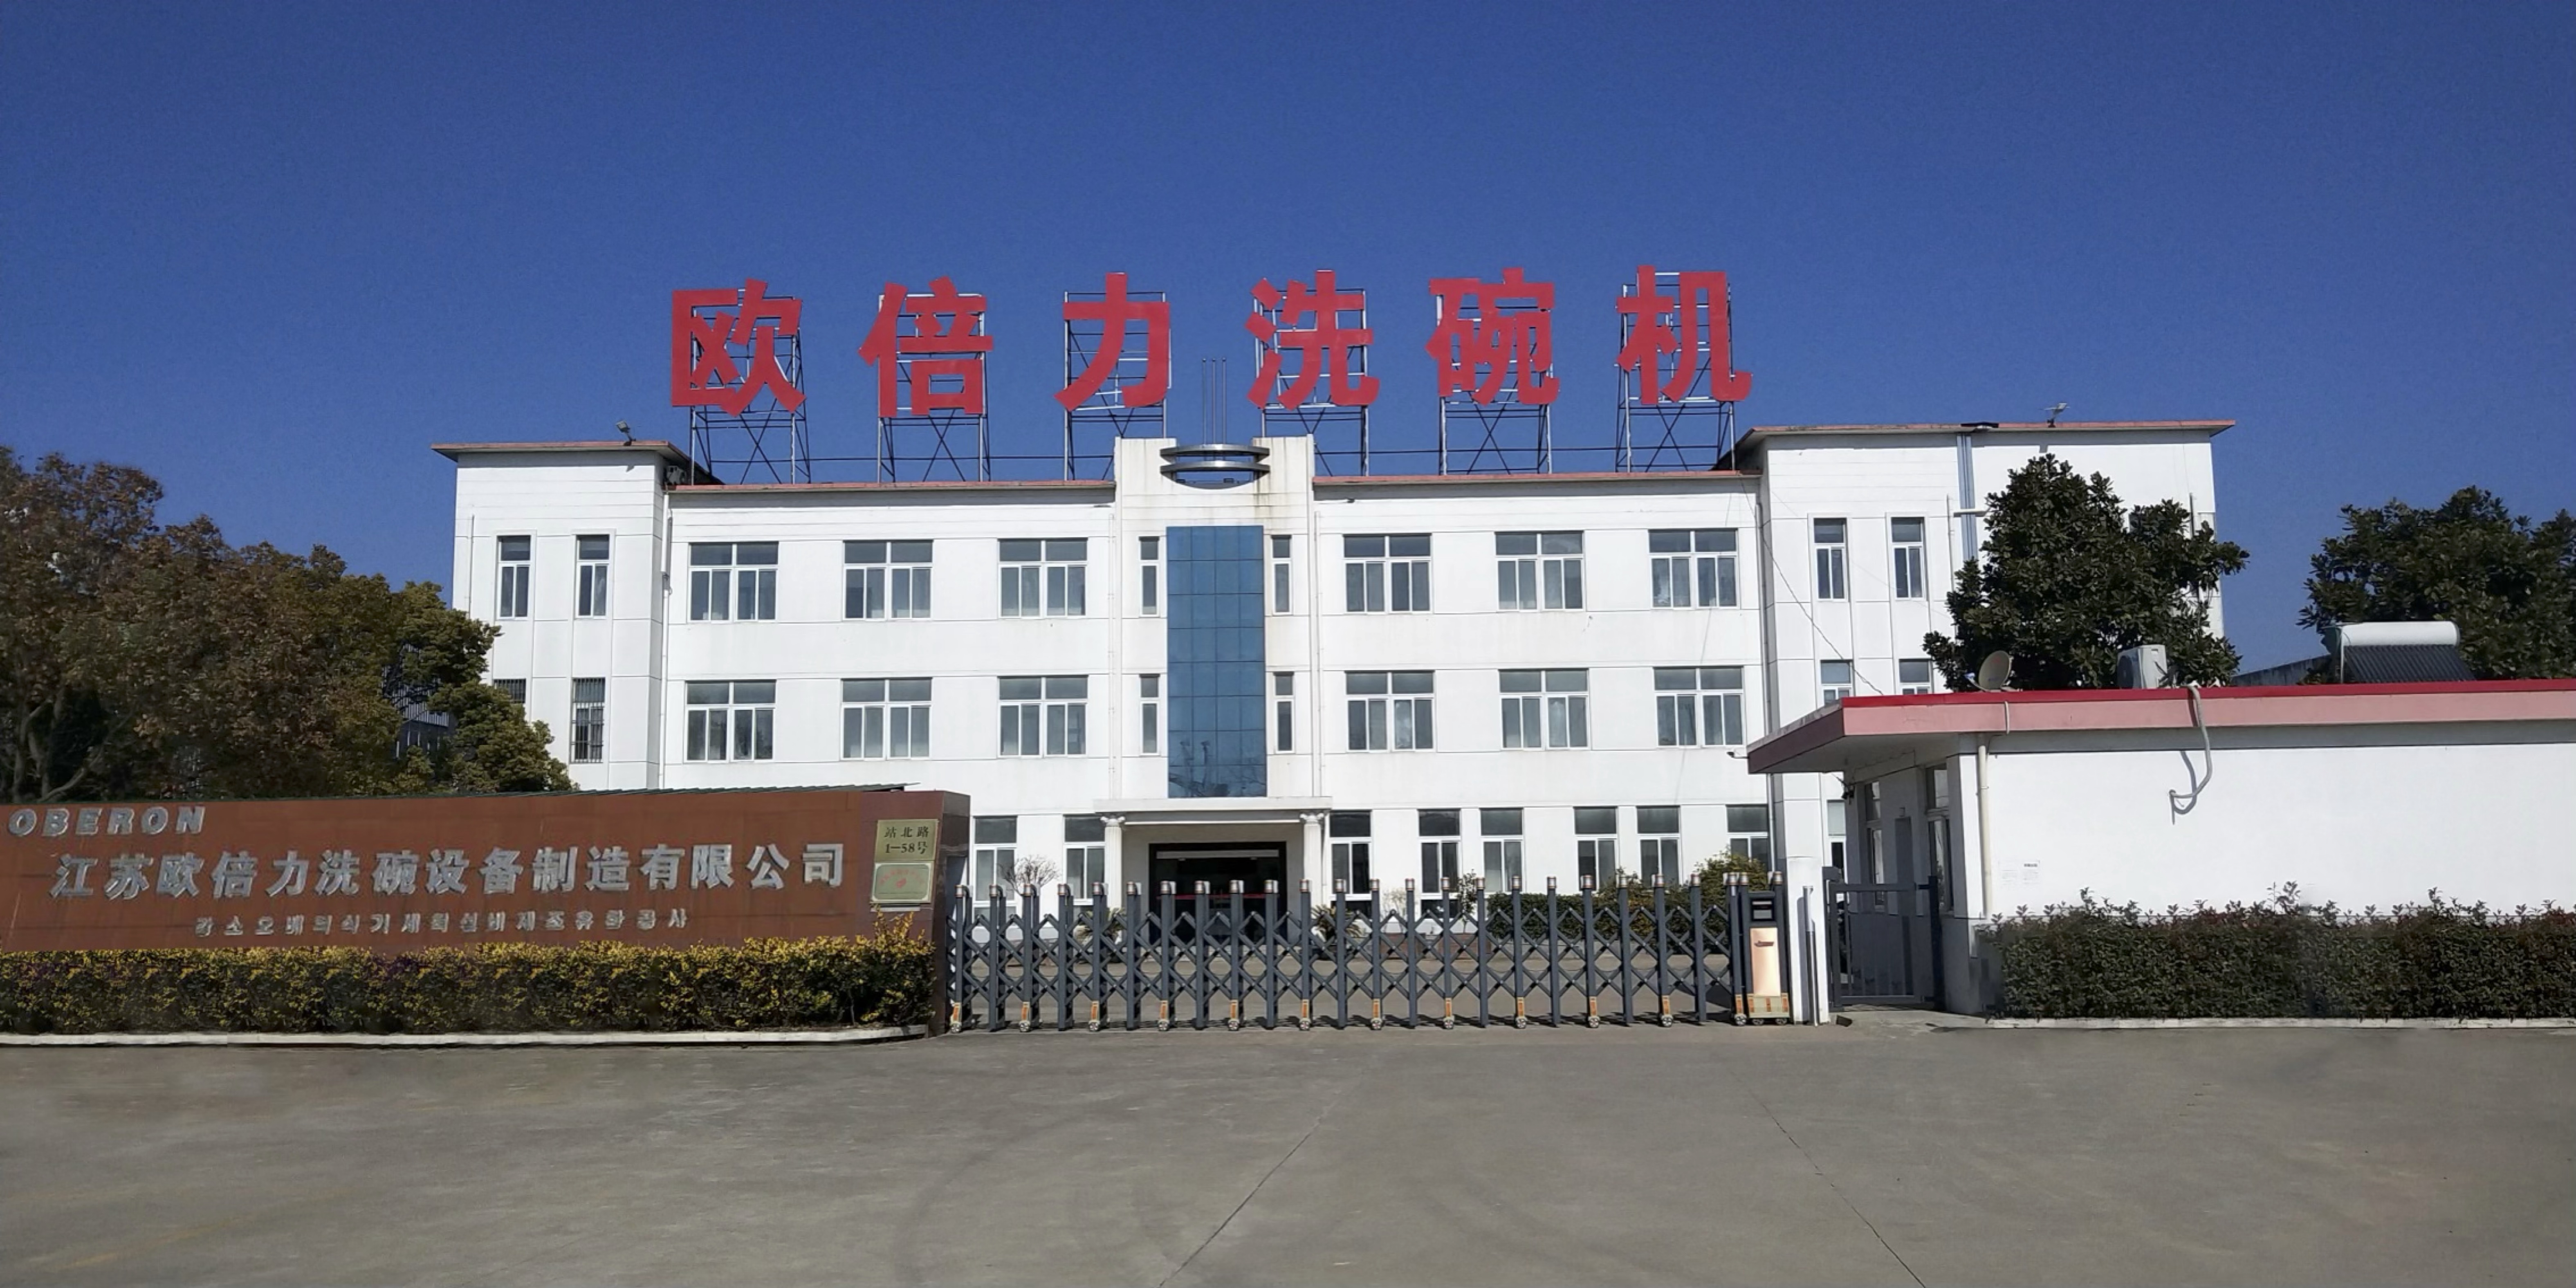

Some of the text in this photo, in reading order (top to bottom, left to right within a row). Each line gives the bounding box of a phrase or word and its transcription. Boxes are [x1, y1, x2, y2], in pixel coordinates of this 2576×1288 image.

[672, 266, 1750, 416] 欧倍力洗碗机
[7, 806, 206, 837] OBERON
[884, 826, 929, 839] 站北路
[49, 843, 844, 900] 江苏欧倍力洗碗设备制造有限公司
